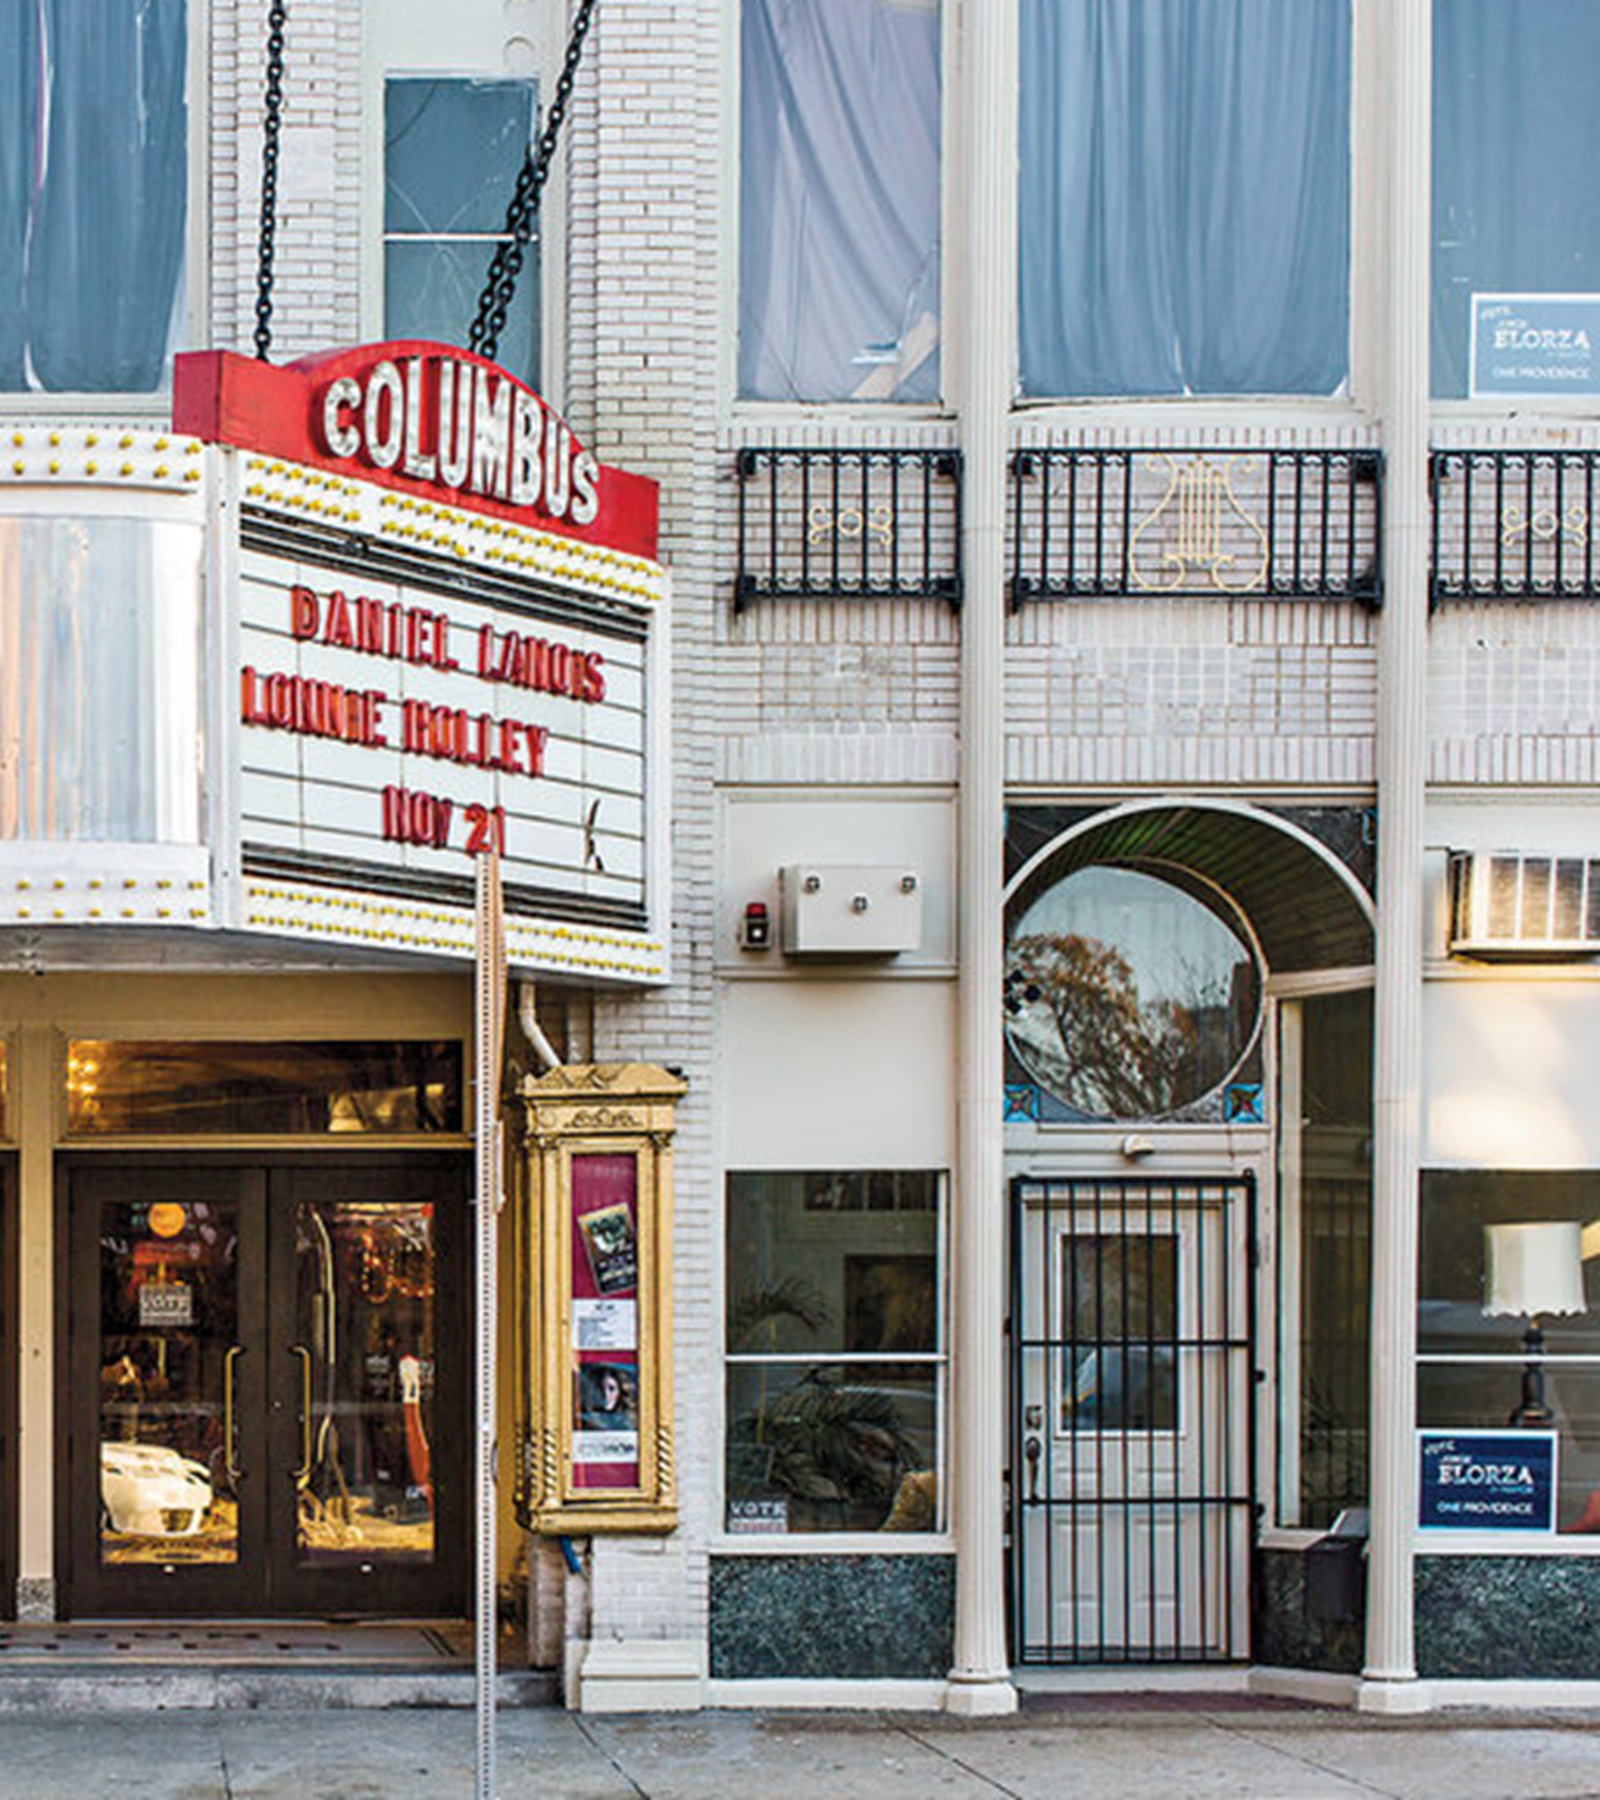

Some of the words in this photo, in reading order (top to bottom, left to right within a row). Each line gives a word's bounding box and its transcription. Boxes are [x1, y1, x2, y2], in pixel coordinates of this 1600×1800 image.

[1494, 328, 1590, 350] ELORZA
[323, 354, 599, 526] COLUMBUS
[290, 583, 459, 671] DANIEL
[240, 664, 387, 750] LONNIE
[403, 697, 549, 779] HOLLEY
[381, 783, 454, 850] NOV
[463, 802, 505, 860] 21
[730, 1500, 788, 1516] VOTE
[1438, 1463, 1534, 1486] ELORZA
